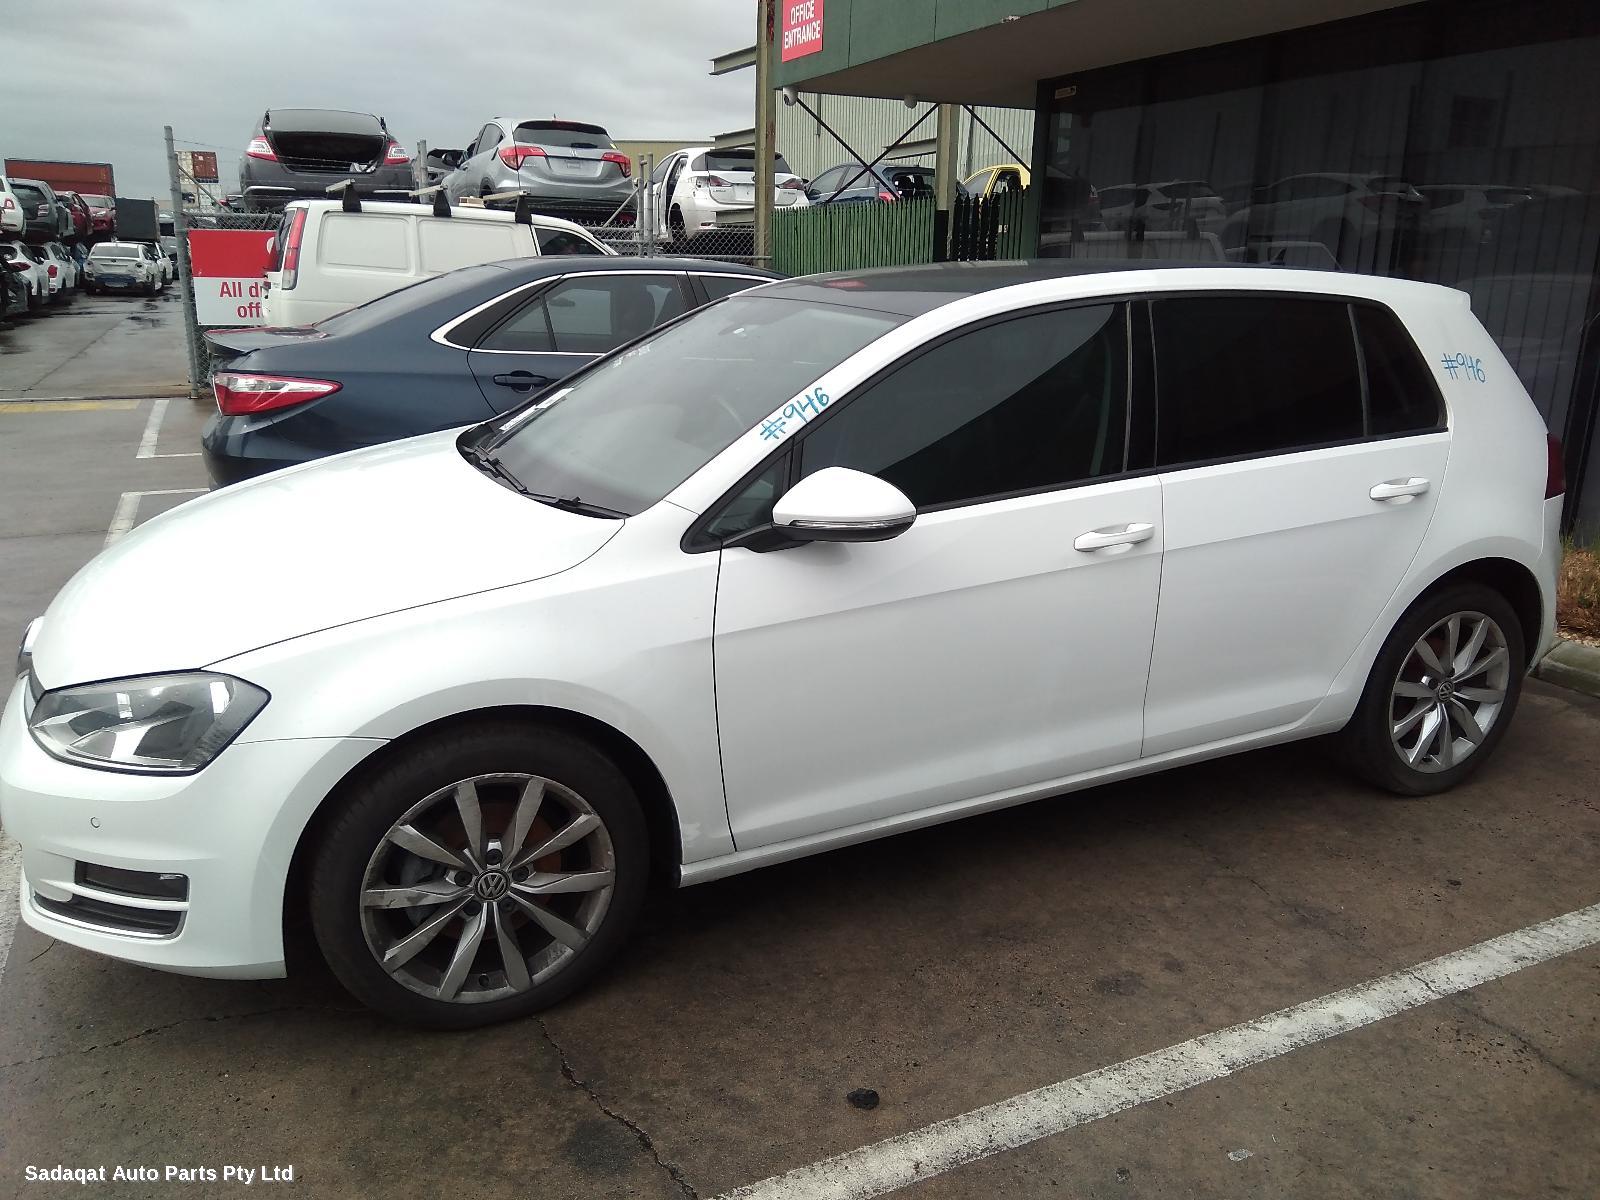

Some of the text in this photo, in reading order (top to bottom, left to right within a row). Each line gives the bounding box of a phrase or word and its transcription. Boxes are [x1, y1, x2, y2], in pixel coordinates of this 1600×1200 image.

[790, 0, 815, 25] OFFICE
[784, 20, 821, 49] ENTRANCE
[219, 281, 243, 298] All
[237, 301, 263, 319] off
[1441, 352, 1486, 383] #946
[760, 387, 830, 440] #946
